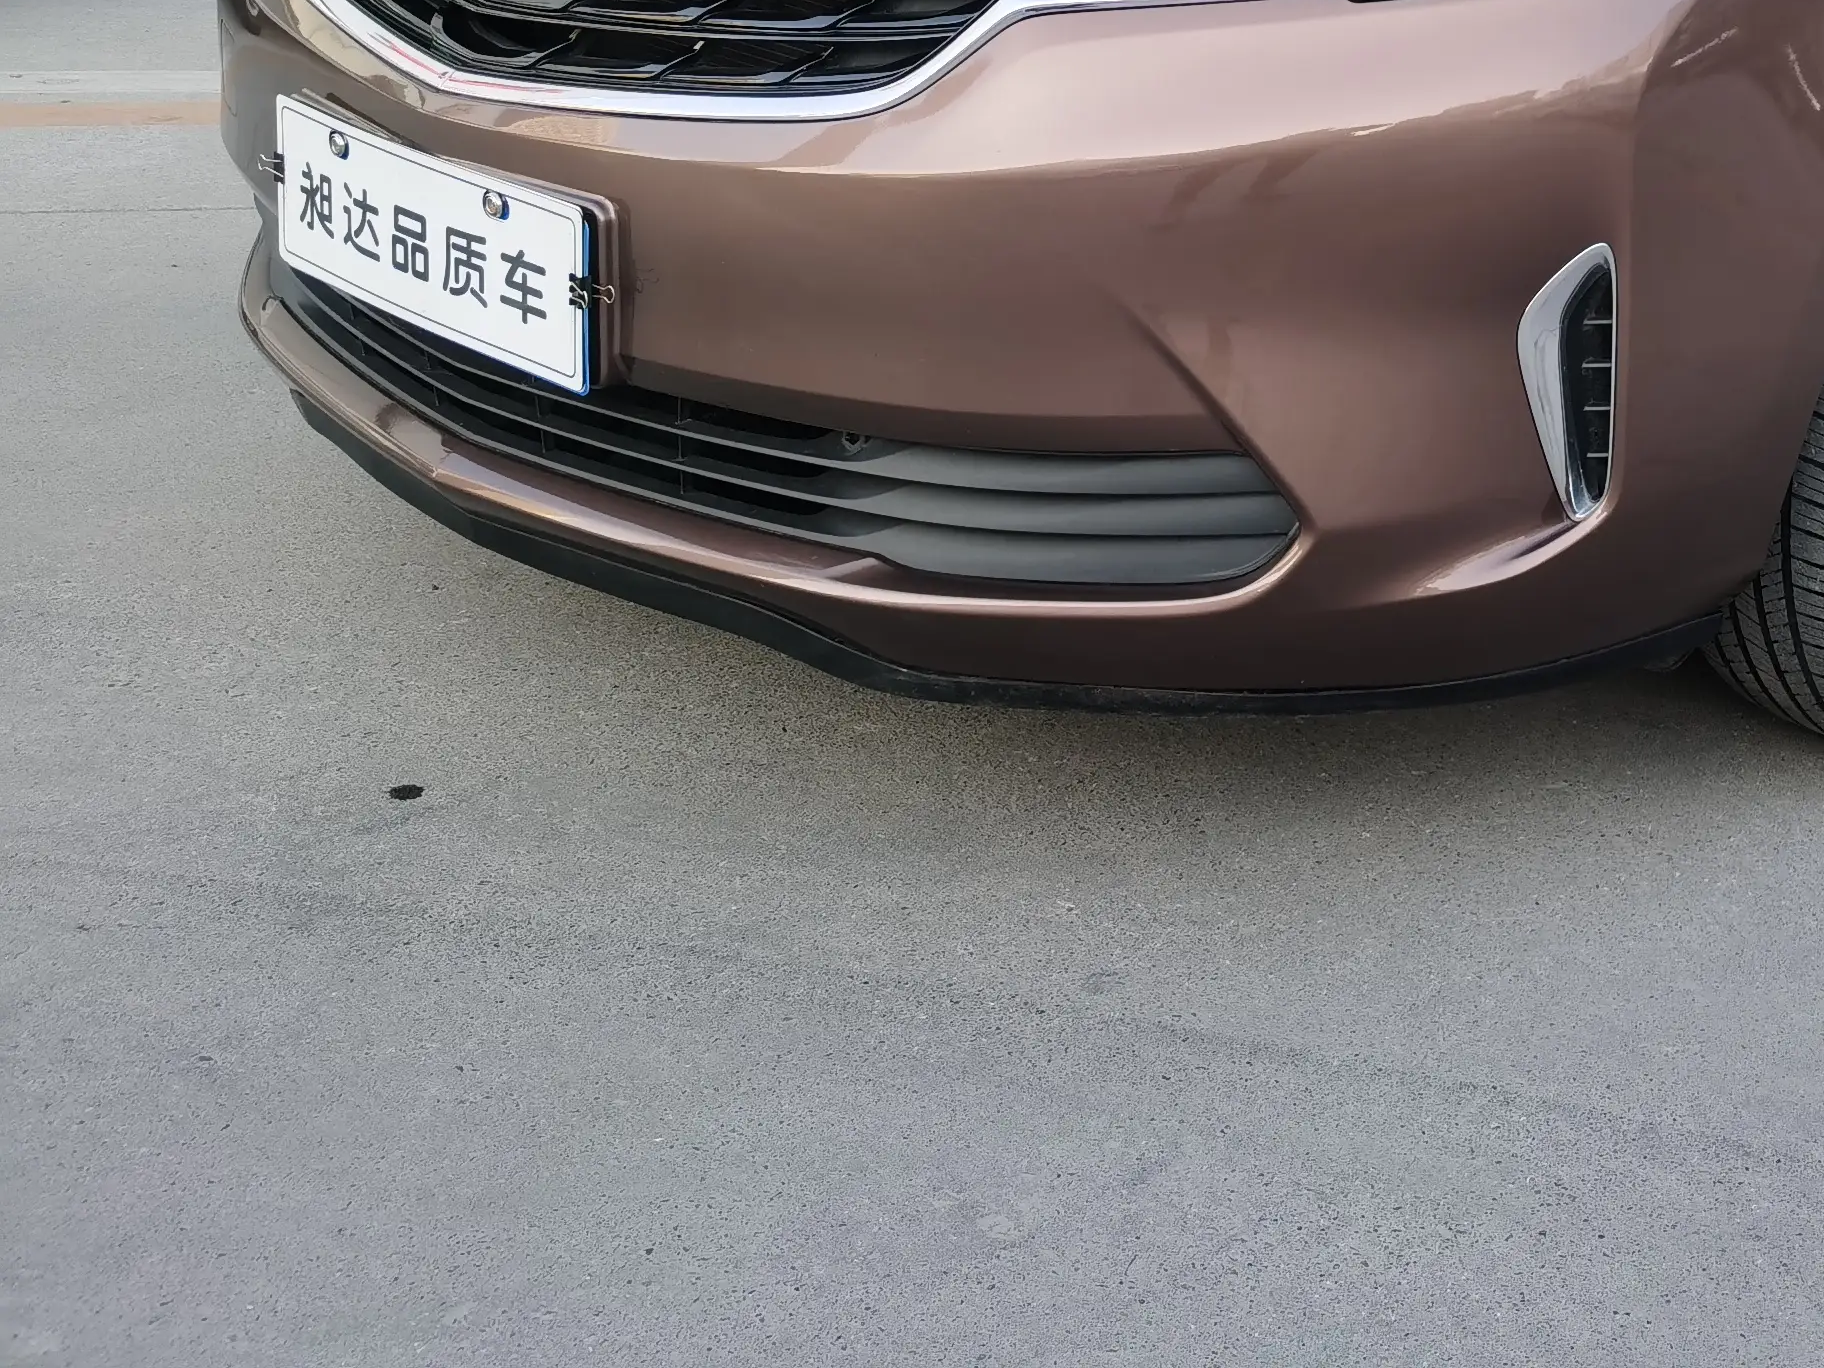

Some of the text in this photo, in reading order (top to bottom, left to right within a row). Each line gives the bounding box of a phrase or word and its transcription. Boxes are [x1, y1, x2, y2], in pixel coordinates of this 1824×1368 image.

[299, 161, 548, 325] 昶达品质车
